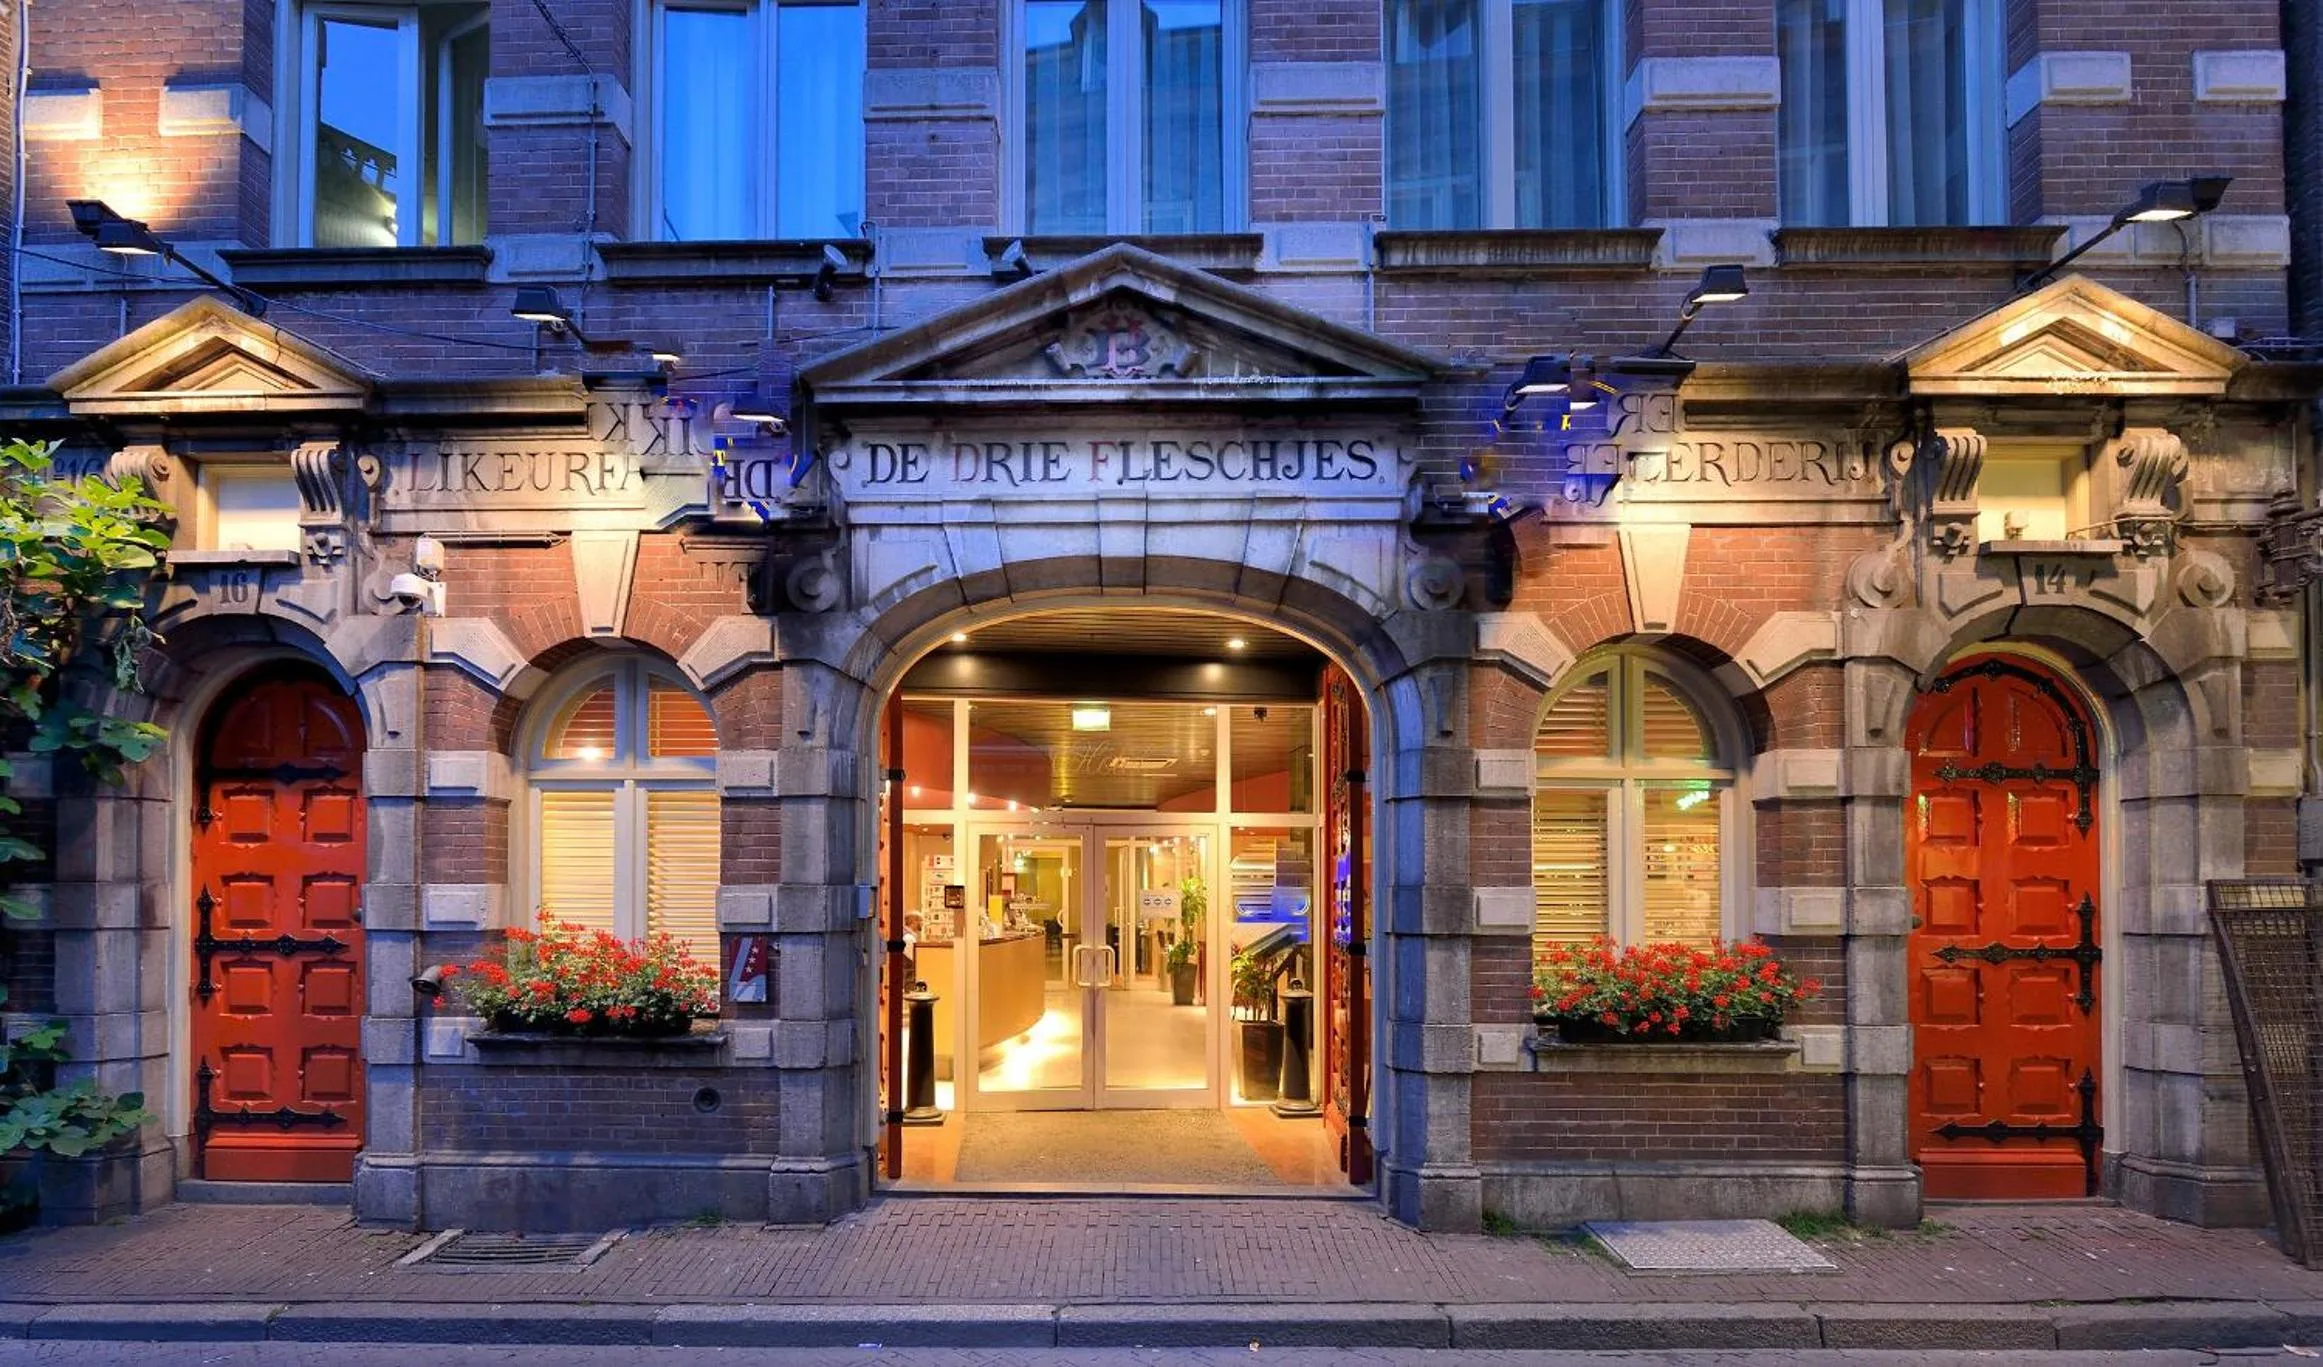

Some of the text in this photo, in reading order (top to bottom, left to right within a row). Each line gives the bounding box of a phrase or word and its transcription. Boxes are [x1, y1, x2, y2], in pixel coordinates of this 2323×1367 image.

[867, 438, 1380, 488] DE DRIE FLESCHJES
[218, 572, 249, 605] 16
[2034, 564, 2068, 596] 14
